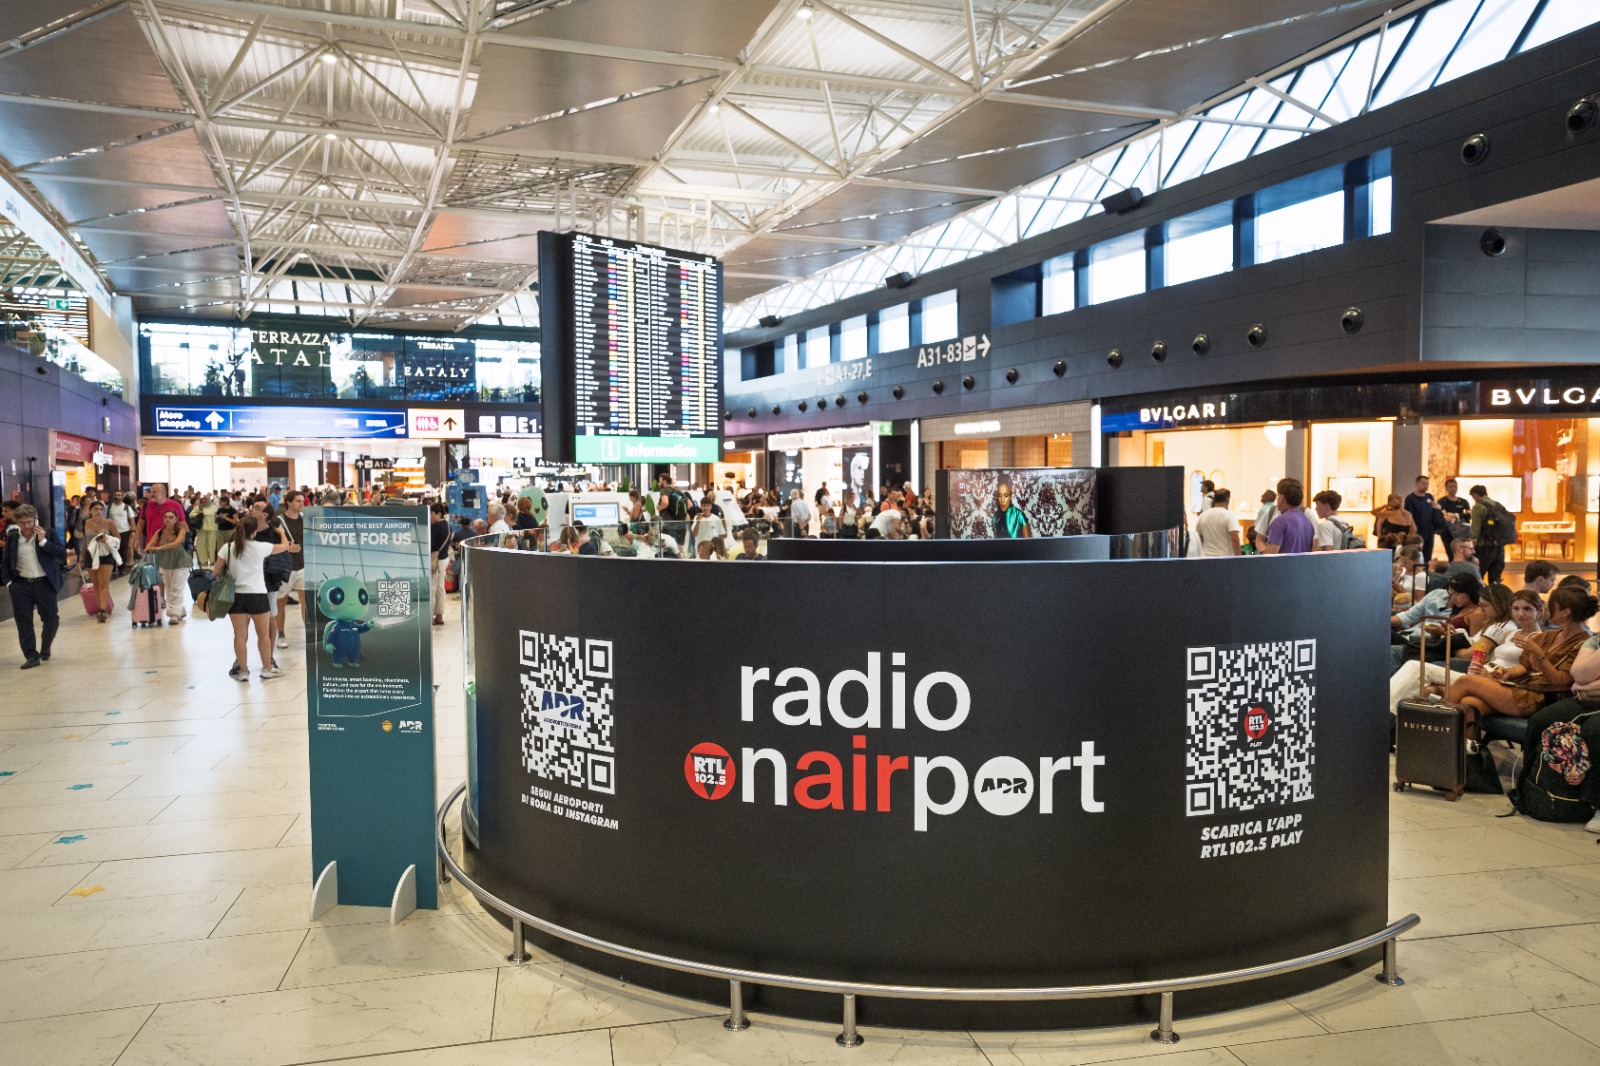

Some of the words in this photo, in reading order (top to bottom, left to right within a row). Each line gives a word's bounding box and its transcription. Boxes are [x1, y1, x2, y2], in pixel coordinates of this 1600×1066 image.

[250, 330, 330, 346] TERRAZZA
[917, 342, 962, 368] A31-83
[404, 366, 470, 378] EATALY
[835, 358, 872, 383] A1-27,E
[160, 411, 183, 420] More
[1140, 402, 1226, 422] BVLGARI
[160, 419, 200, 429] shopping
[626, 442, 697, 458] Information
[319, 532, 357, 545] VOTE
[360, 532, 388, 545] FOR
[392, 532, 411, 545] US
[741, 652, 971, 731] radio
[541, 690, 584, 721] ADR
[399, 720, 422, 730] ADR
[1248, 715, 1264, 726] RTL
[1404, 722, 1450, 732] SUITSUIT
[694, 756, 726, 775] RTL
[694, 773, 726, 786] 102.5
[981, 778, 1028, 794] ADR
[530, 786, 552, 801] SEGUI
[553, 792, 603, 814] AEROPORTI
[521, 794, 529, 804] DI
[530, 796, 552, 812] ROMA
[553, 805, 564, 816] SU
[566, 807, 619, 830] INSTAGRAM
[1200, 821, 1262, 841] SCARICA
[1266, 813, 1302, 832] L'APP
[1270, 829, 1303, 849] PLAY
